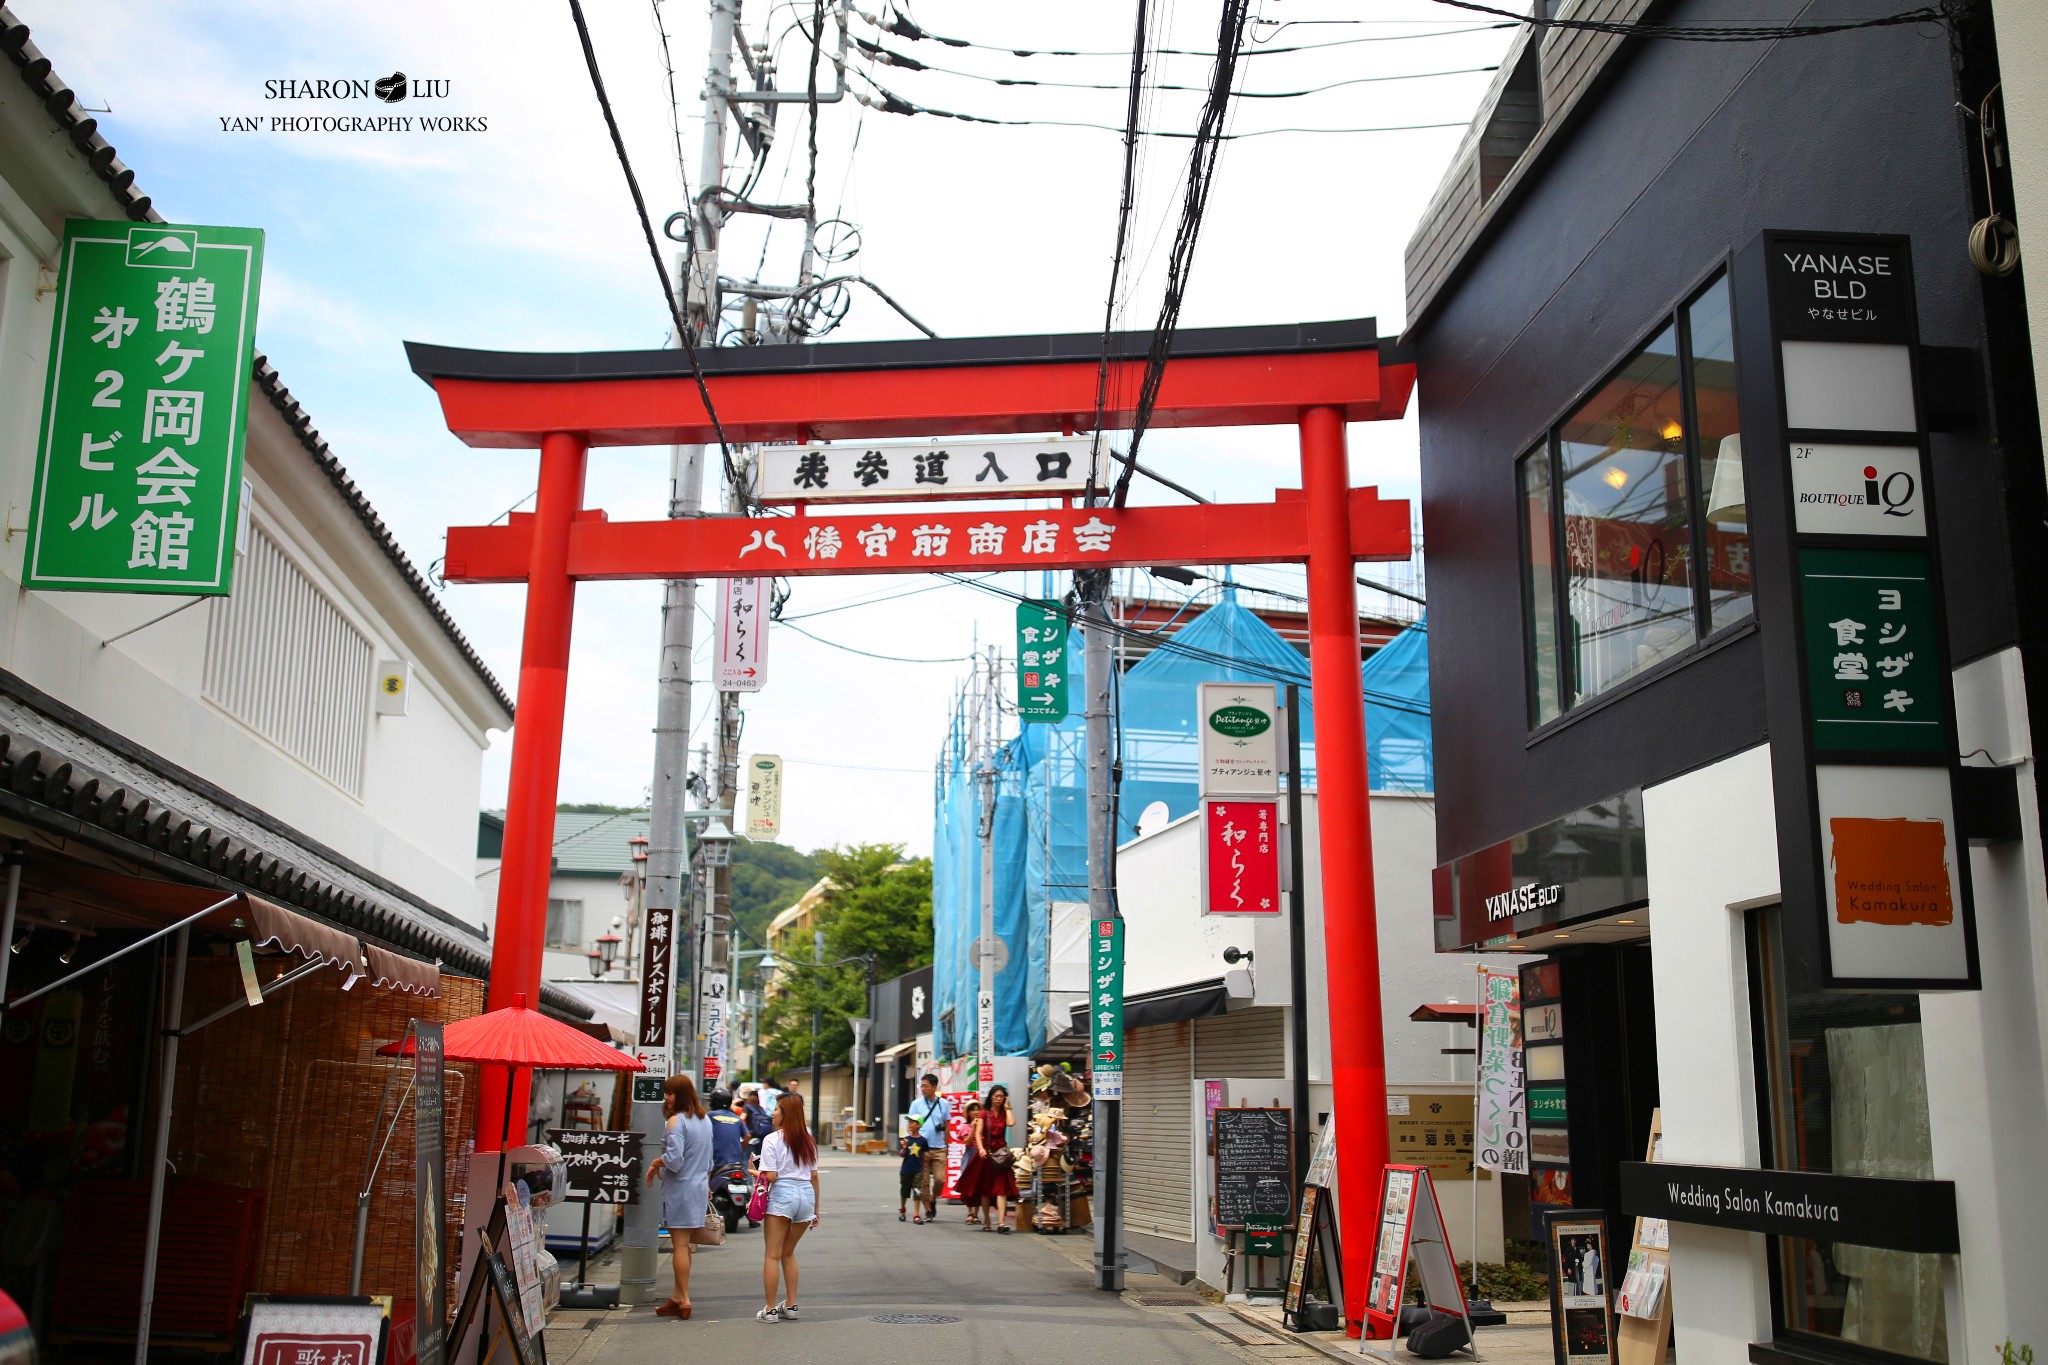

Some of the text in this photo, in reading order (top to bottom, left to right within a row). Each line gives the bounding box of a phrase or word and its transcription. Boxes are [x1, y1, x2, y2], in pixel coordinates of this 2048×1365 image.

[1783, 253, 1892, 276] YANASE
[1814, 279, 1867, 300] BLD
[1807, 307, 1878, 321] やなせビル
[794, 450, 1072, 489] 表参道入口
[1796, 447, 1814, 459] 2F
[1800, 492, 1865, 506] BOUTIQUE
[738, 516, 1117, 560] 八幡宮前商店会
[732, 598, 754, 662] 和らく
[1591, 598, 1631, 633] BOUTIQUE
[1021, 626, 1040, 667] 食堂
[1042, 607, 1063, 688] ヨシザキ
[1828, 618, 1869, 680] 食堂
[1876, 589, 1914, 713] ヨシザキ
[722, 679, 757, 687] 24-0463
[1220, 820, 1247, 909] 和らく
[1486, 883, 1560, 922] YANASE BLD
[1847, 880, 1938, 894] Wedding Salon
[1849, 895, 1939, 912] Kamakura
[1097, 939, 1116, 1047] ヨシザキ食堂
[1533, 1099, 1567, 1109] ヨシザキ食堂
[594, 1187, 630, 1203] 入口
[1667, 1182, 1839, 1222] Wedding Salon Kamakura
